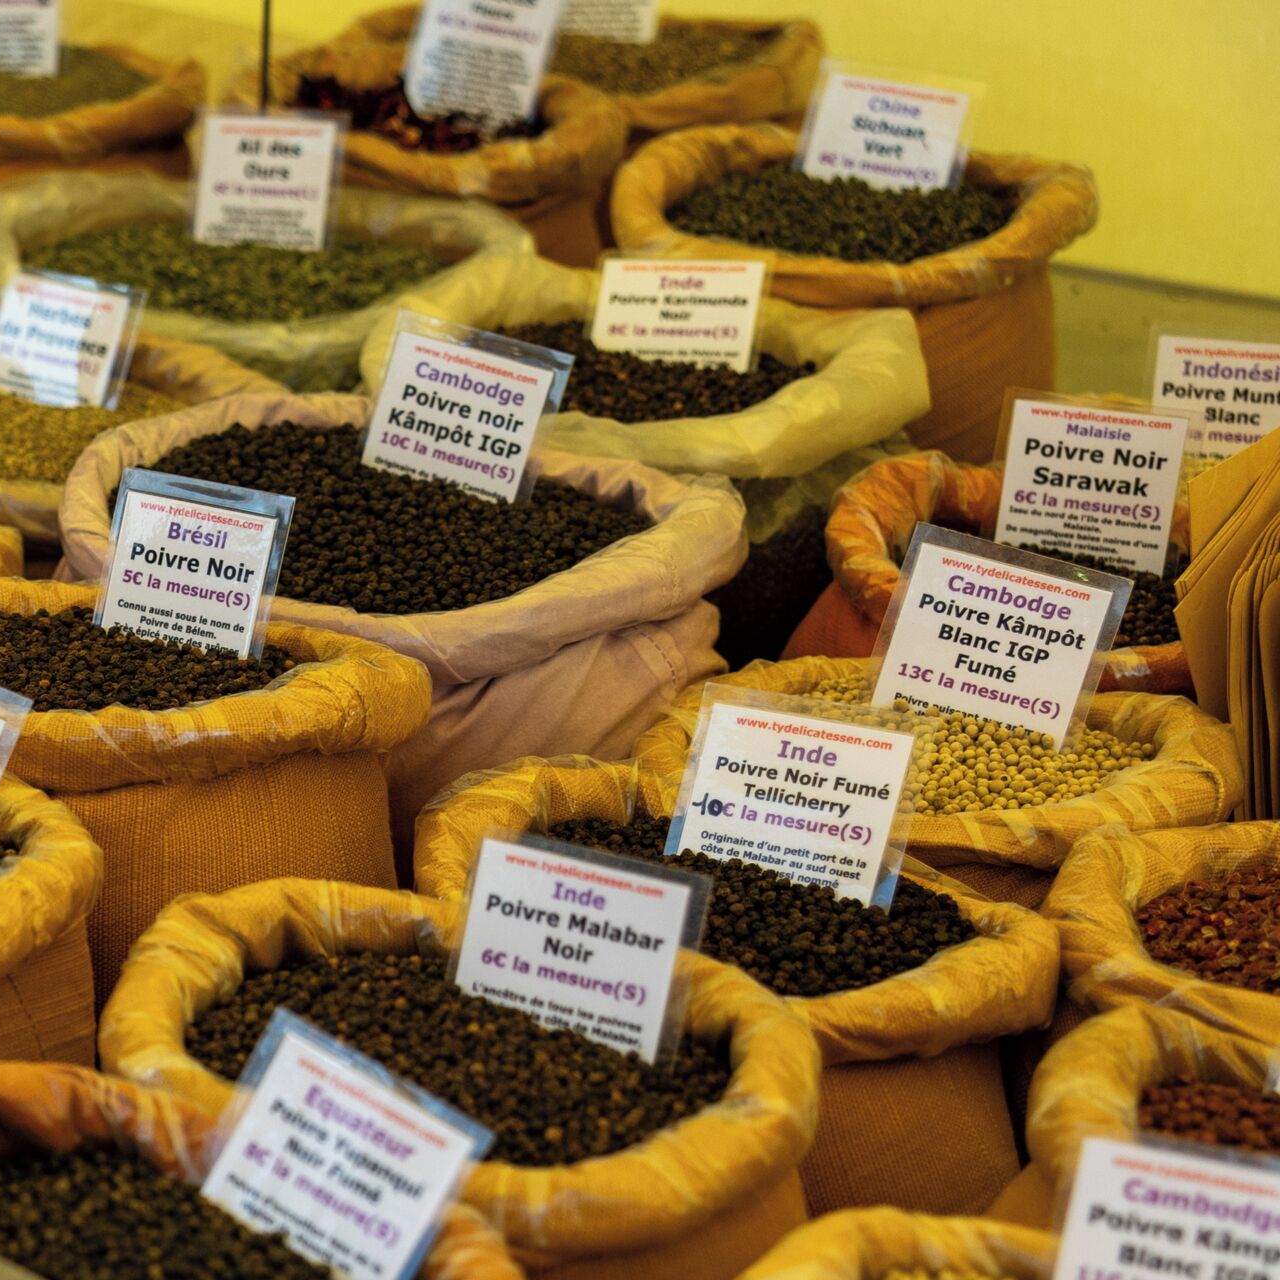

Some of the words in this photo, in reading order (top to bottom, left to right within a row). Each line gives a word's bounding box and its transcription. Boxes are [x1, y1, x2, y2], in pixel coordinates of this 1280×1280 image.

[867, 96, 923, 119] Chine
[863, 139, 904, 159] Vert
[658, 274, 705, 290] Inde
[658, 309, 692, 321] Noir
[414, 360, 525, 407] Cambodge
[1160, 380, 1226, 402] Poivre
[400, 383, 472, 419] Poivre
[476, 408, 524, 433] noir
[386, 406, 474, 448] Kâmpôt
[476, 433, 522, 459] IGP
[1065, 422, 1132, 442] Malaisie
[1023, 436, 1105, 464] Poivre
[1112, 446, 1168, 471] Noir
[1031, 465, 1149, 498] Sarawak
[166, 520, 228, 550] Brésil
[129, 541, 200, 573] Poivre
[205, 556, 255, 584] Noir
[941, 556, 1091, 602] www.tydelicatessen.com
[121, 568, 144, 586] 5€
[145, 572, 162, 590] la
[165, 579, 251, 611] mesure(S)
[946, 573, 1072, 621] Cambodge
[138, 614, 170, 630] Poivre
[170, 621, 184, 633] de
[184, 623, 217, 640] Bélem.
[917, 592, 990, 626] Poivre
[995, 611, 1086, 650] Kâmpôt
[936, 622, 1001, 654] Blanc
[1004, 639, 1050, 665] IGP
[953, 652, 1017, 683] Fumé
[896, 662, 934, 683] 13€
[936, 671, 955, 689] la
[958, 680, 1061, 720] mesure(S)
[735, 716, 893, 751] www.tydelicatessen.com
[776, 738, 838, 767] Inde
[714, 754, 778, 780] Poivre
[782, 766, 829, 789] Noir
[831, 775, 890, 800] Fumé
[742, 781, 851, 819] Tellicherry
[739, 803, 758, 822] la
[763, 811, 872, 846] mesure(S)
[699, 829, 755, 848] Originaire
[755, 839, 781, 853] d'un
[782, 846, 811, 859] petit
[811, 851, 837, 864] port
[837, 855, 854, 867] de
[854, 857, 867, 869] la
[551, 880, 606, 911] Inde
[484, 892, 561, 928] Poivre
[566, 912, 665, 952] Malabar
[542, 935, 594, 964] Noir
[511, 954, 531, 975] la
[535, 964, 647, 1007] mesure(S)
[302, 1083, 415, 1160] Equateur
[283, 1136, 324, 1167] Noir
[326, 1163, 382, 1203] Fumé
[1117, 1242, 1201, 1280] Blanc
